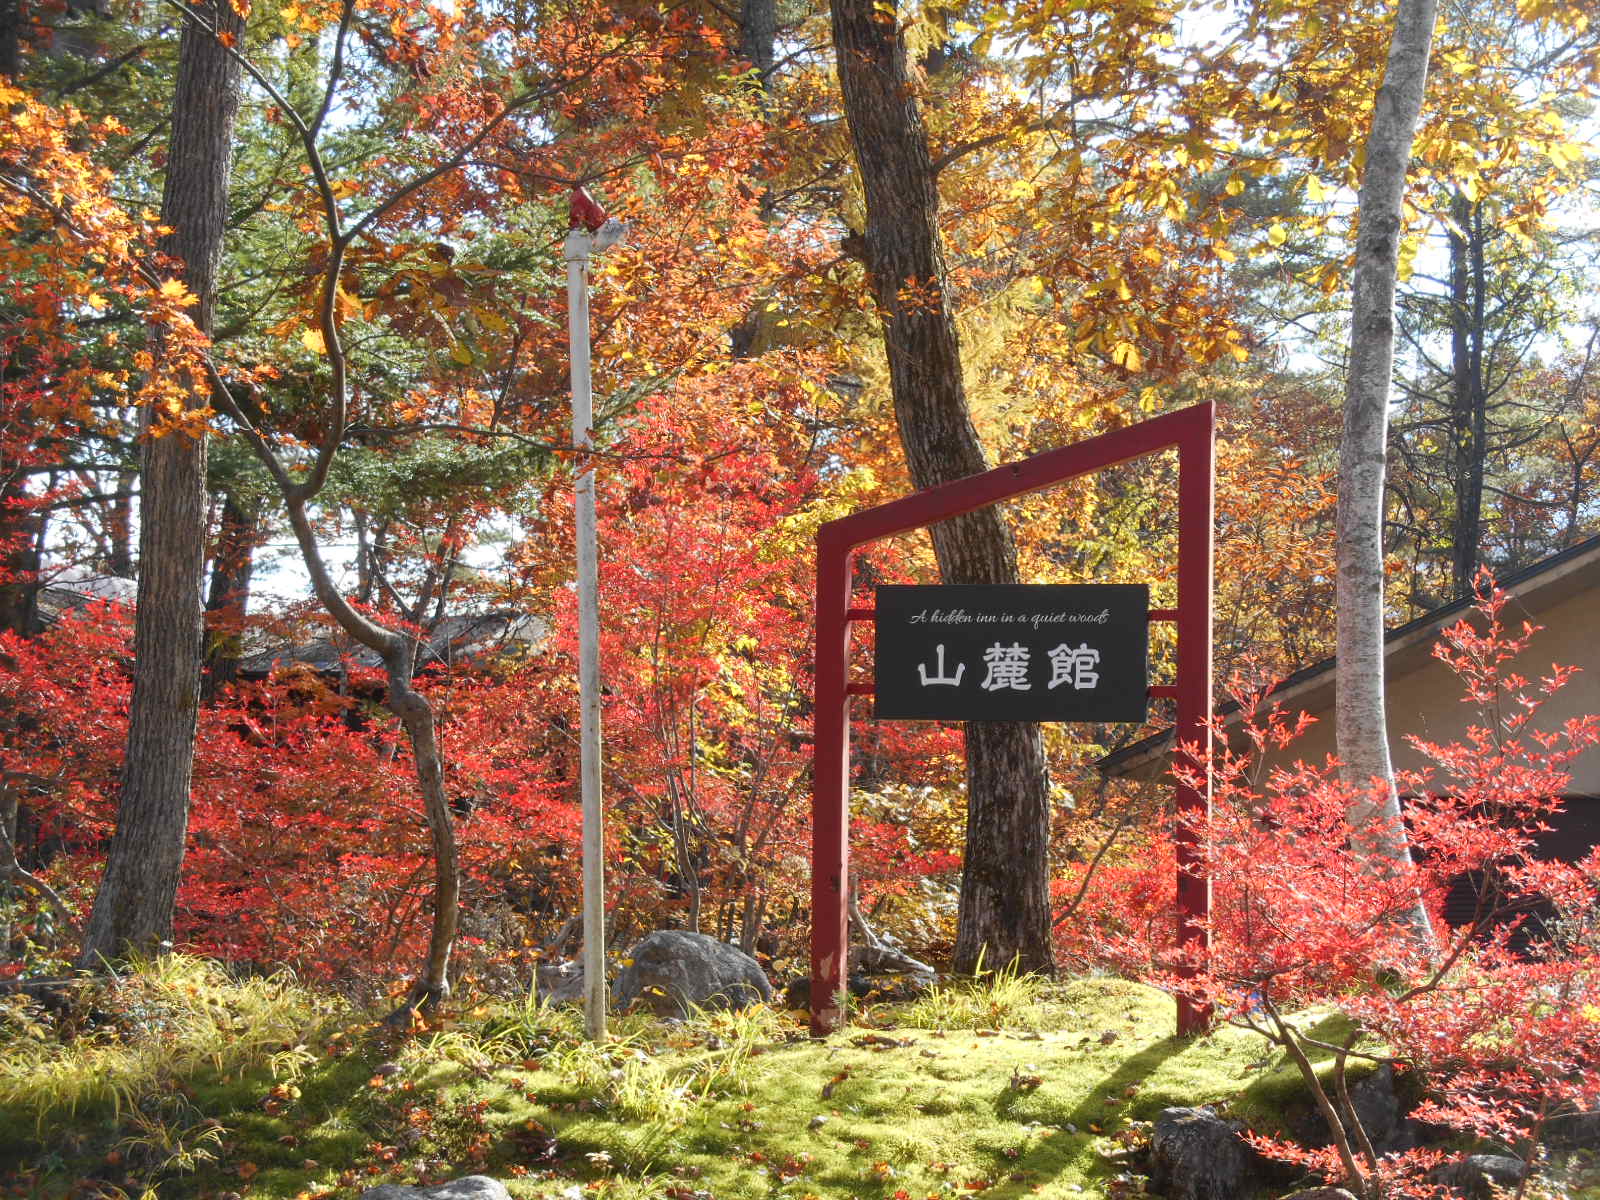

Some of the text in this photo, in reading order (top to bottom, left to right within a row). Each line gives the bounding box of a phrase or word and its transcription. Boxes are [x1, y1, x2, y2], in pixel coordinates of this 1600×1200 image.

[908, 609, 1110, 630] A hidden inn in a quiet woods
[917, 641, 1101, 692] 山麓館
